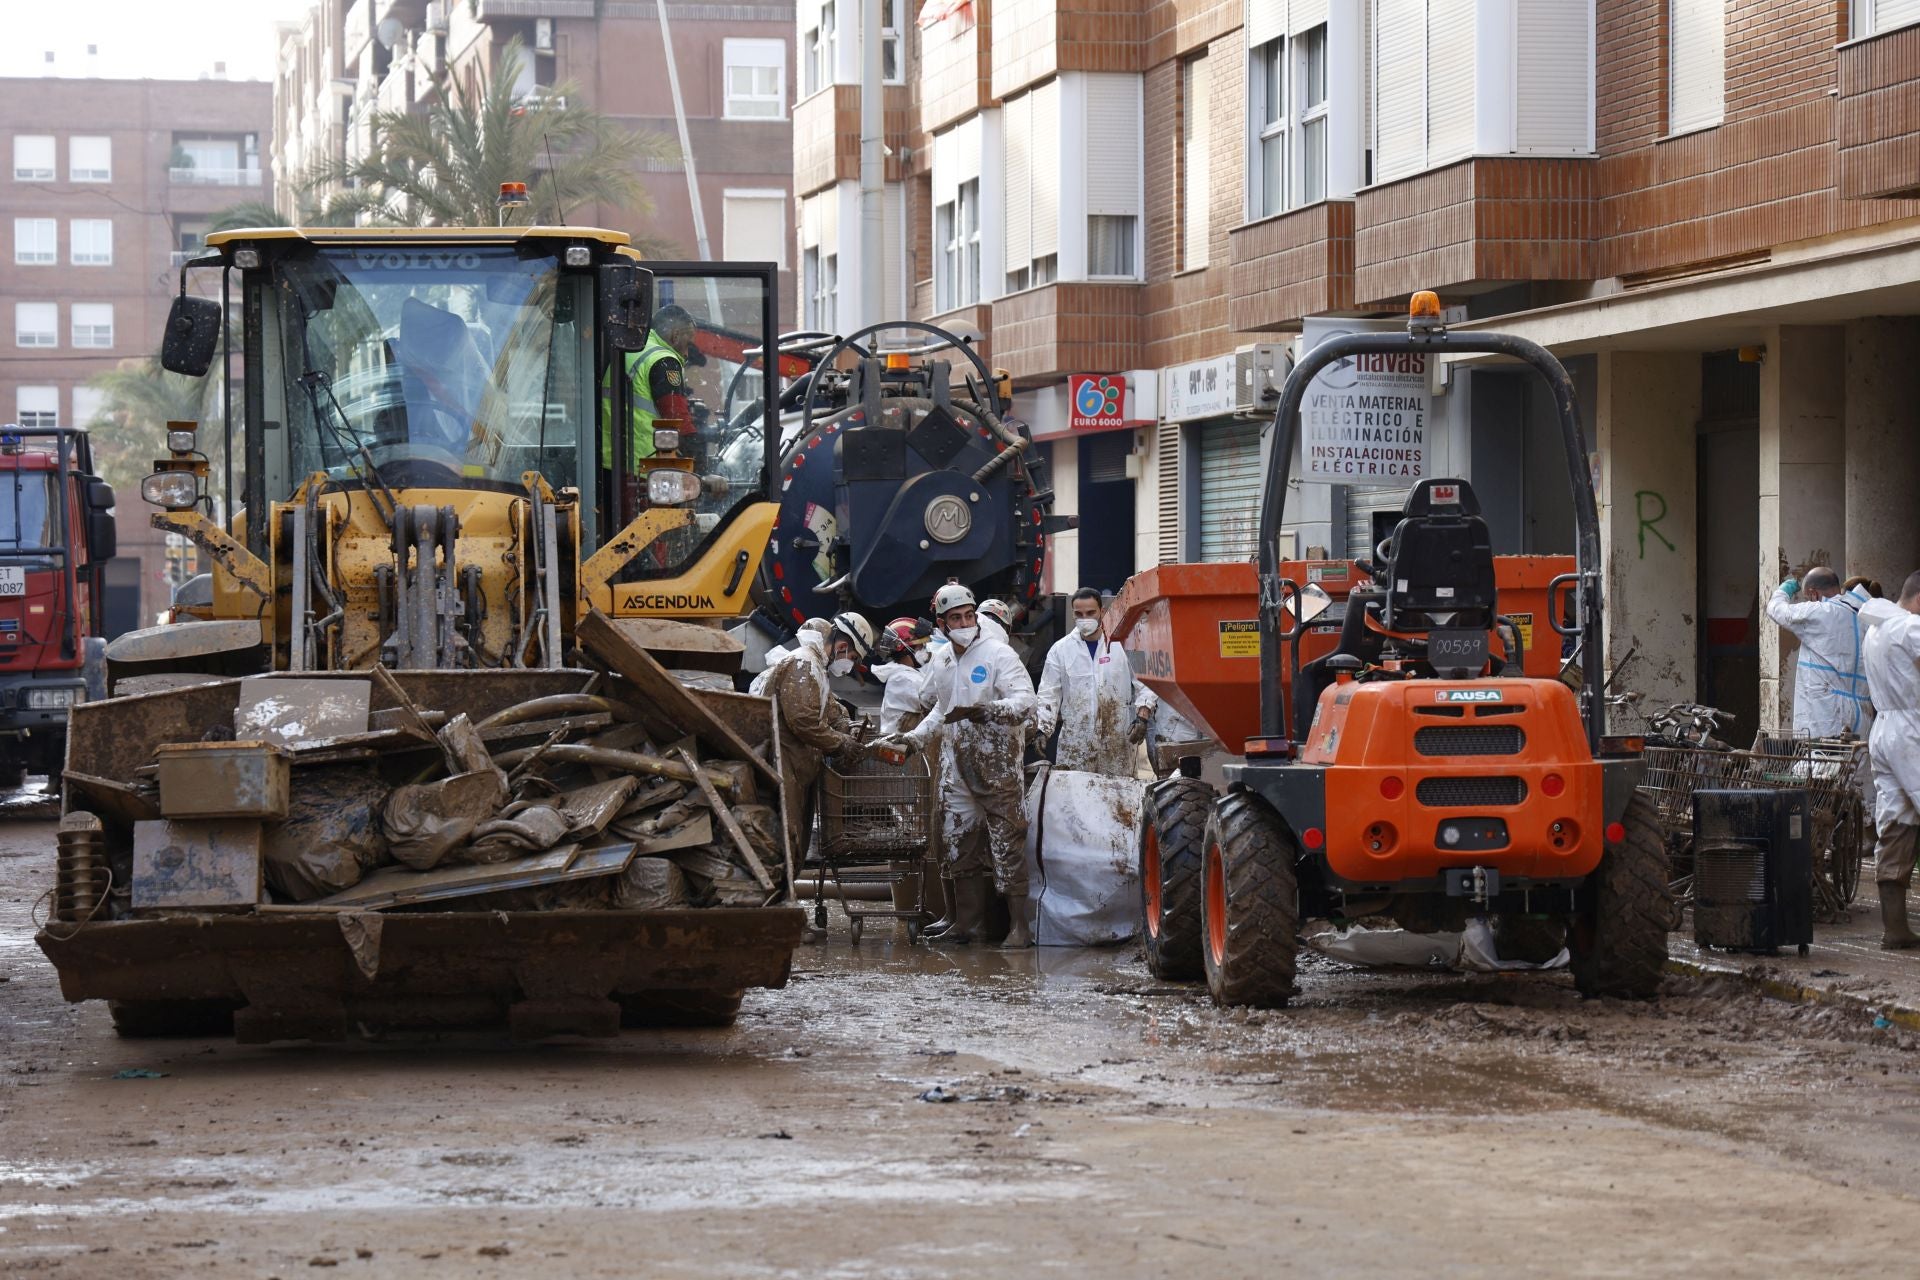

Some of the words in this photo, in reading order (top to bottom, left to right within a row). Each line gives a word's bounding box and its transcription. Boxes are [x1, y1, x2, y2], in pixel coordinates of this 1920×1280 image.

[357, 252, 481, 270] VOLVO
[1311, 395, 1355, 409] VENTA
[1359, 395, 1424, 411] MATERIAL
[1074, 418, 1097, 426] EURO
[1099, 418, 1122, 426] 6000
[1311, 409, 1401, 427] ELÉCTRICO
[1416, 414, 1423, 428] E
[1311, 426, 1422, 443] ILUMINACIÓN
[1312, 459, 1421, 476] ELÉCTRICAS
[1634, 490, 1676, 560] R
[0, 583, 23, 593] 087
[623, 594, 715, 609] ASCENDUM
[1225, 622, 1256, 632] ¡Peligro!
[1450, 691, 1500, 700] AUSA
